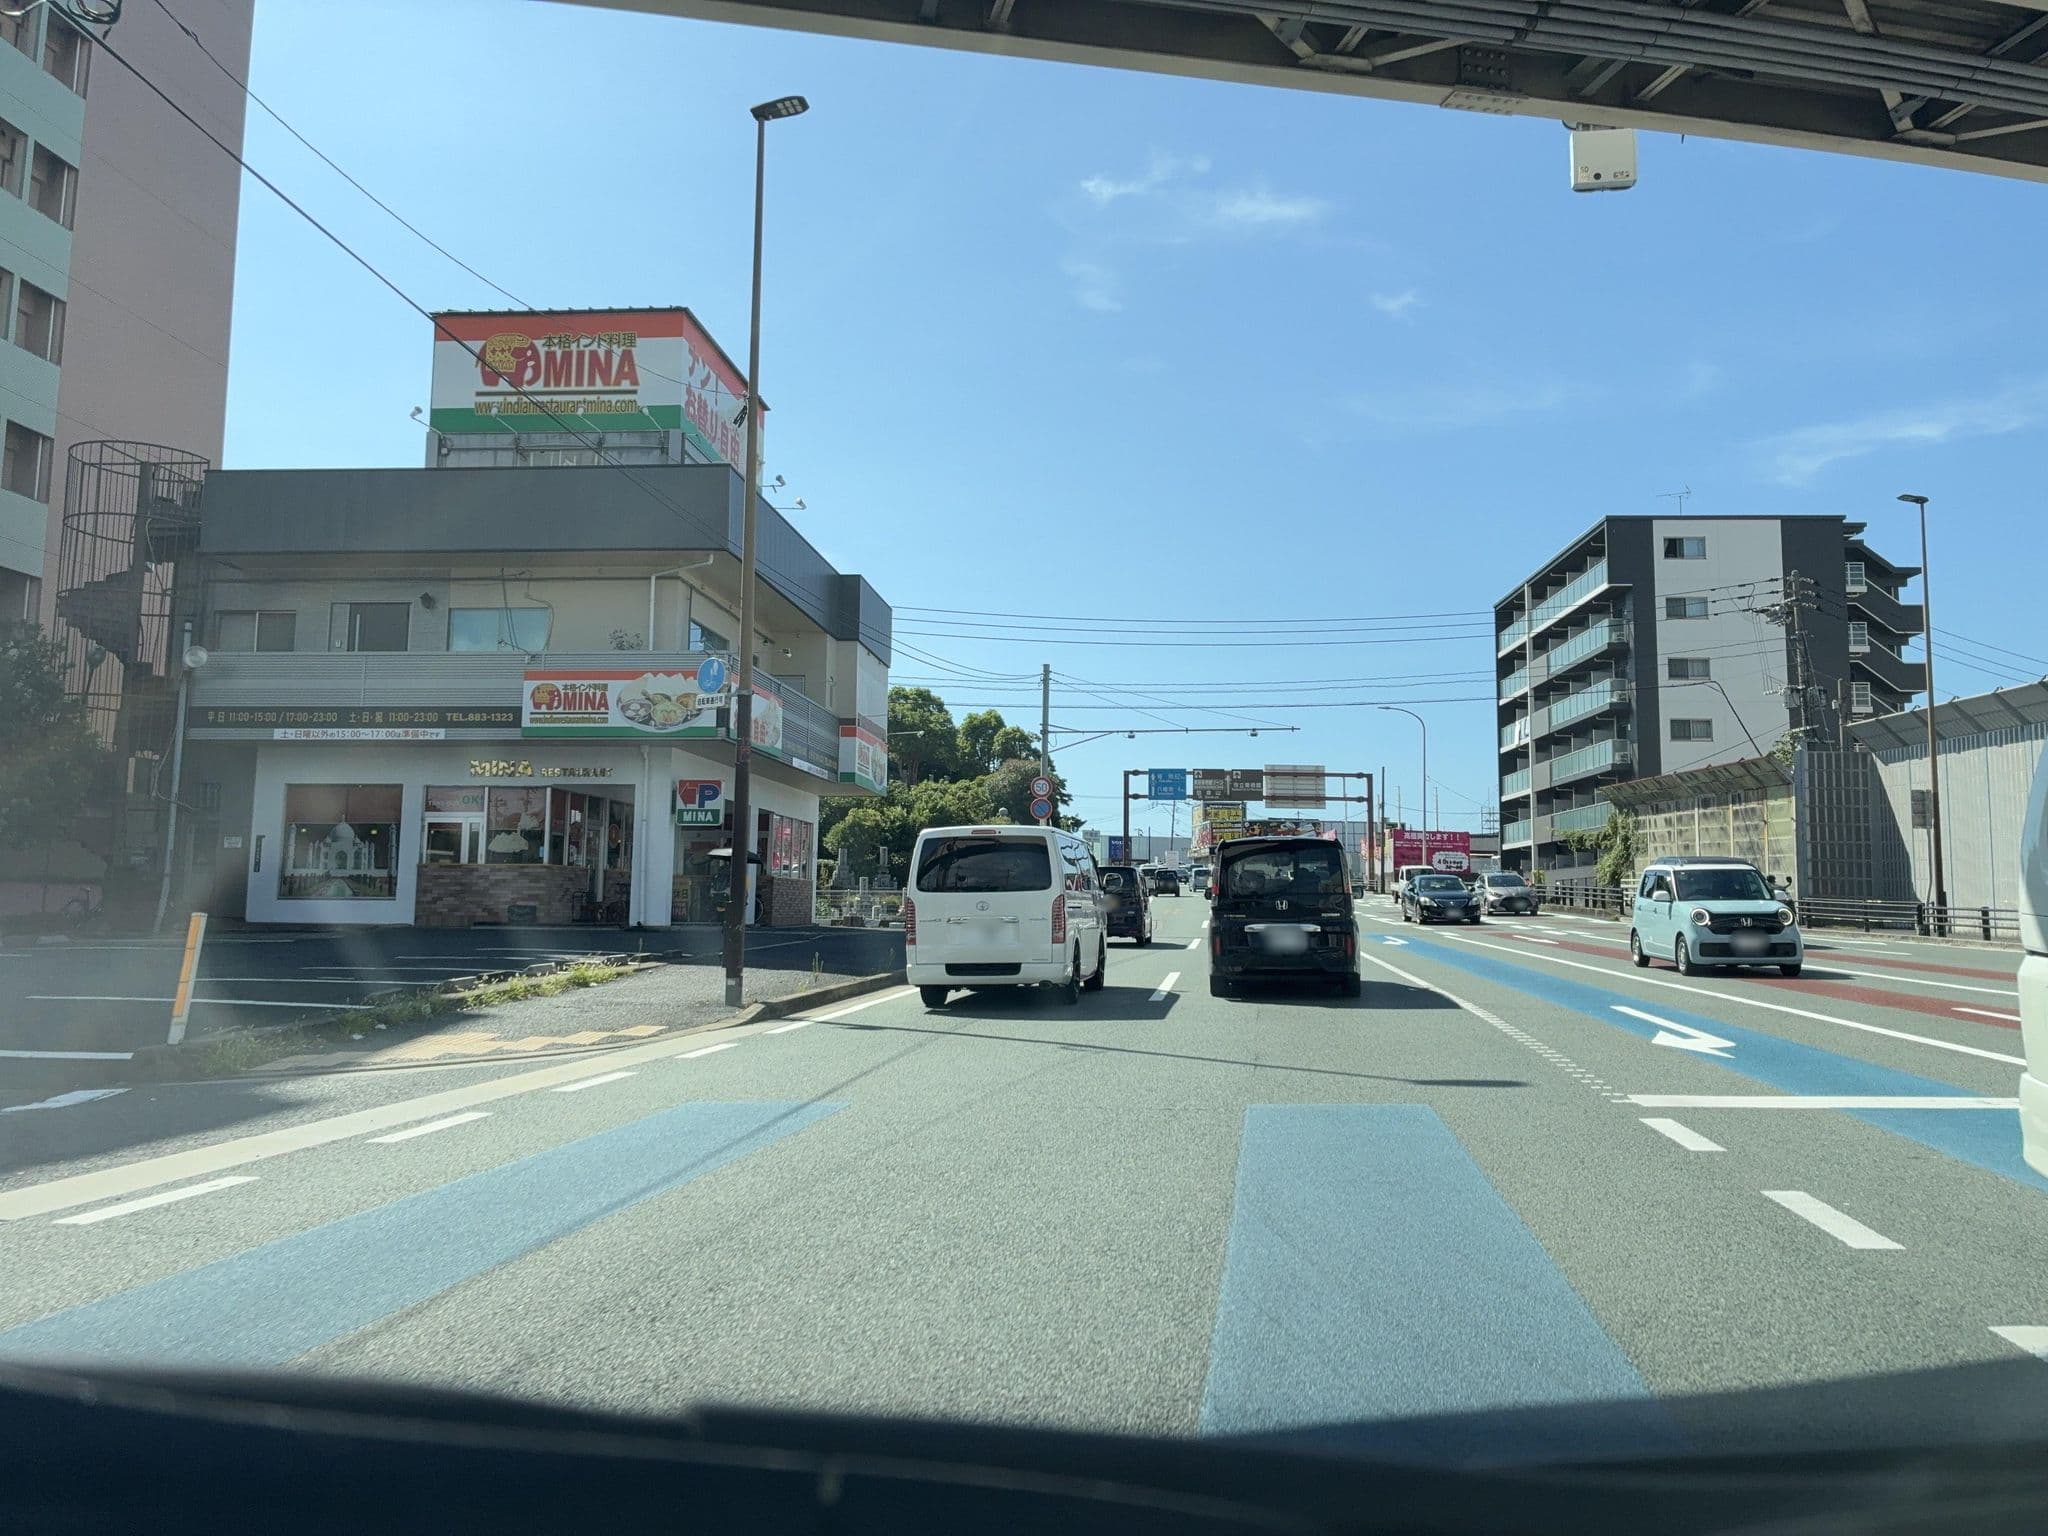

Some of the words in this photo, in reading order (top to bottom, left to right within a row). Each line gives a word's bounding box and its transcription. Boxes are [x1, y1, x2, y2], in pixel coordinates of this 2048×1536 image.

[543, 332, 637, 349] 本格インド料理
[543, 349, 640, 388] MINA
[562, 692, 609, 710] MINA
[1035, 782, 1048, 792] 50
[698, 784, 721, 808] P
[683, 811, 713, 822] MINA
